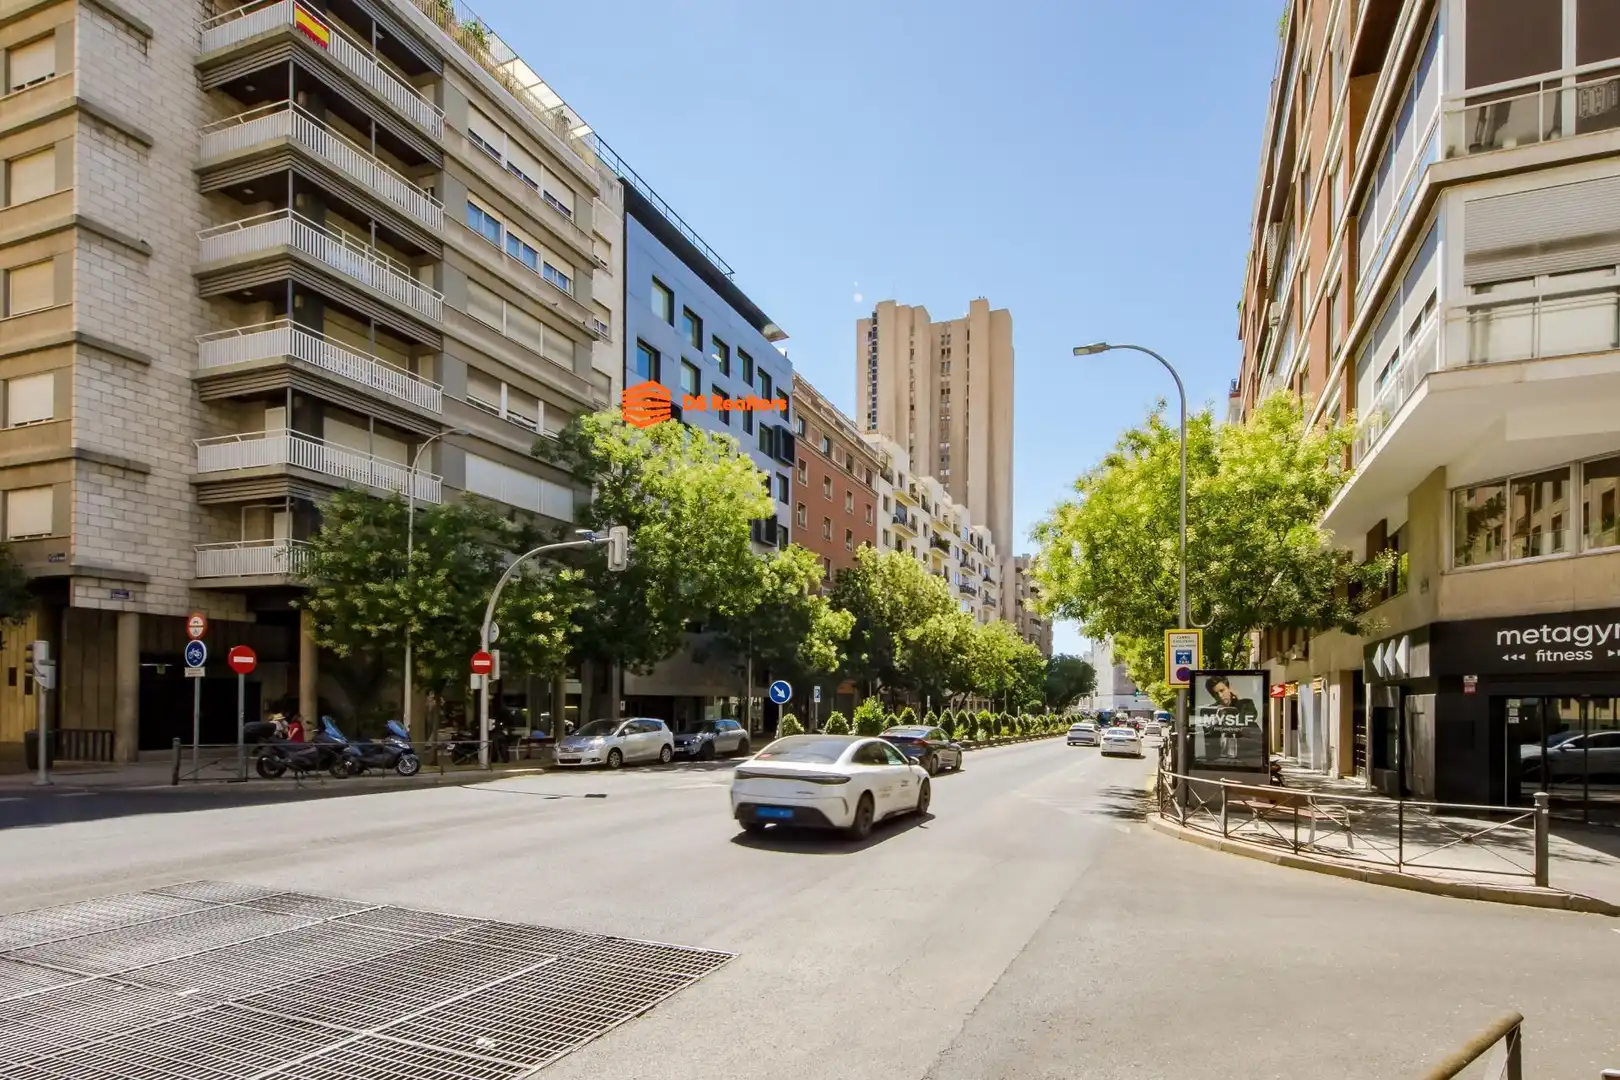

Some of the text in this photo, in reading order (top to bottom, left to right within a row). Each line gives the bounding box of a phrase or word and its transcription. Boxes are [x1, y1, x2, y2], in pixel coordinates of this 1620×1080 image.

[1496, 622, 1620, 647] metagy
[1535, 649, 1594, 662] fitness
[1203, 713, 1255, 726] MYSLF
